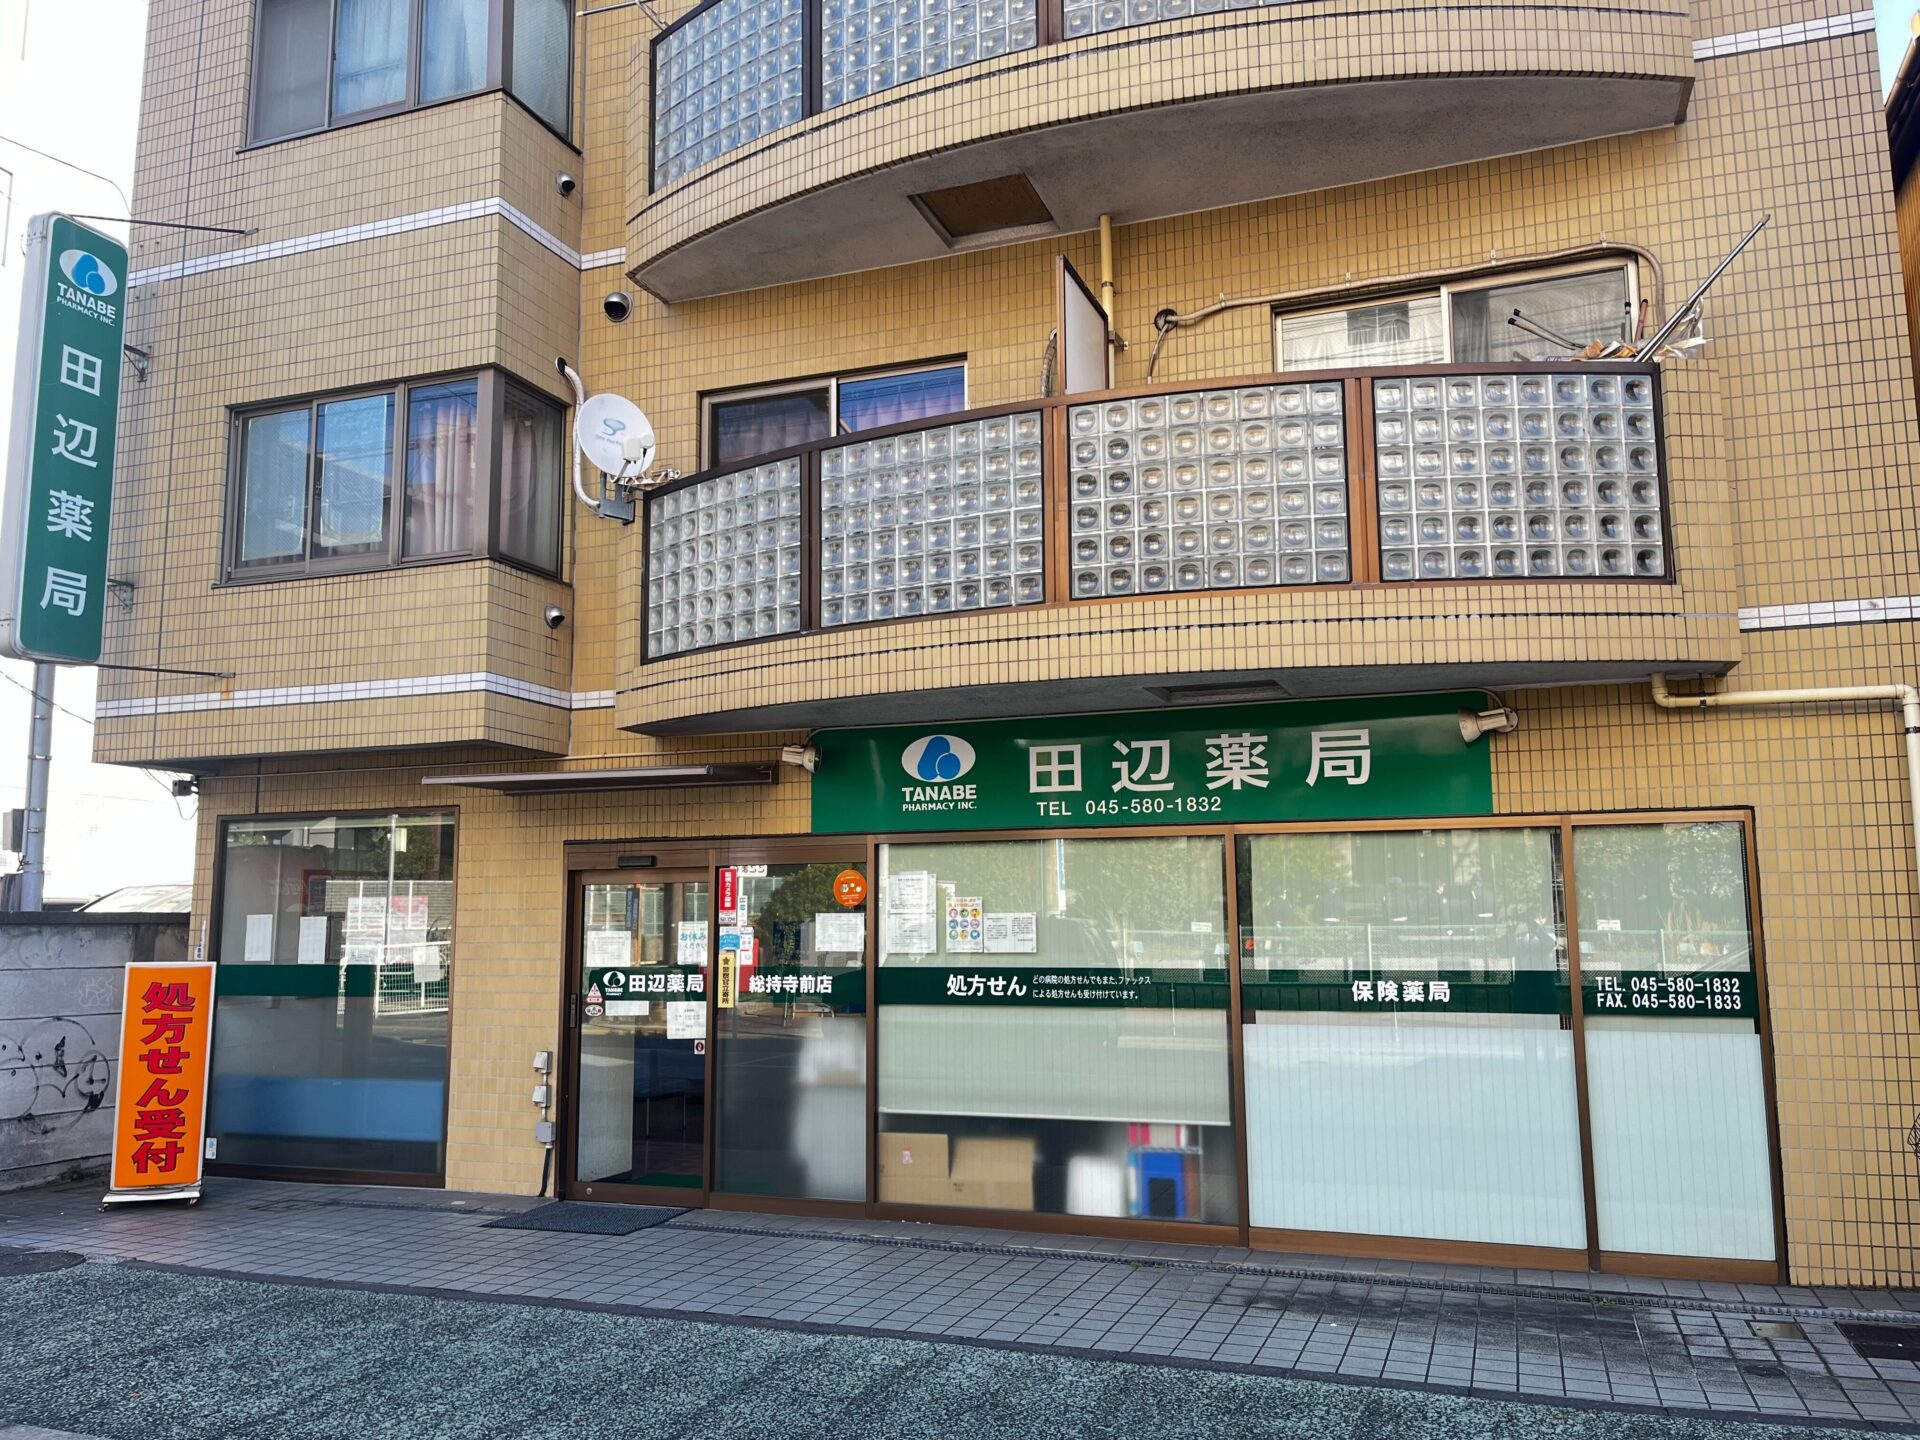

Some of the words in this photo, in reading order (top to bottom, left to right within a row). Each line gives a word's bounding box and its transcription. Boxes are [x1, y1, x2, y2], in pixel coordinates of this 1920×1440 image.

[57, 282, 117, 319] TANABE
[56, 296, 99, 320] PHARMACY
[100, 315, 116, 327] INC.
[40, 343, 104, 618] 田辺薬局
[1028, 729, 1371, 793] 田辺薬局
[902, 784, 977, 802] TANABE
[902, 802, 955, 812] PHARMACY
[958, 800, 977, 810] INC.
[1037, 802, 1072, 816] TEL
[1086, 796, 1222, 815] 045-580-1832
[628, 973, 705, 994] 田辺薬局
[748, 974, 833, 995] 総持寺前店
[946, 974, 1027, 997] 処方せん
[1350, 980, 1451, 1003] 保険薬局
[1595, 976, 1626, 992] TEL.
[1631, 977, 1741, 993] 045-580-1832
[1032, 989, 1139, 1000] による処方せんも受け付けています。
[1596, 993, 1628, 1009] FAX.
[1632, 994, 1742, 1010] 045-580-1833
[131, 981, 196, 1174] 処方せん受付
